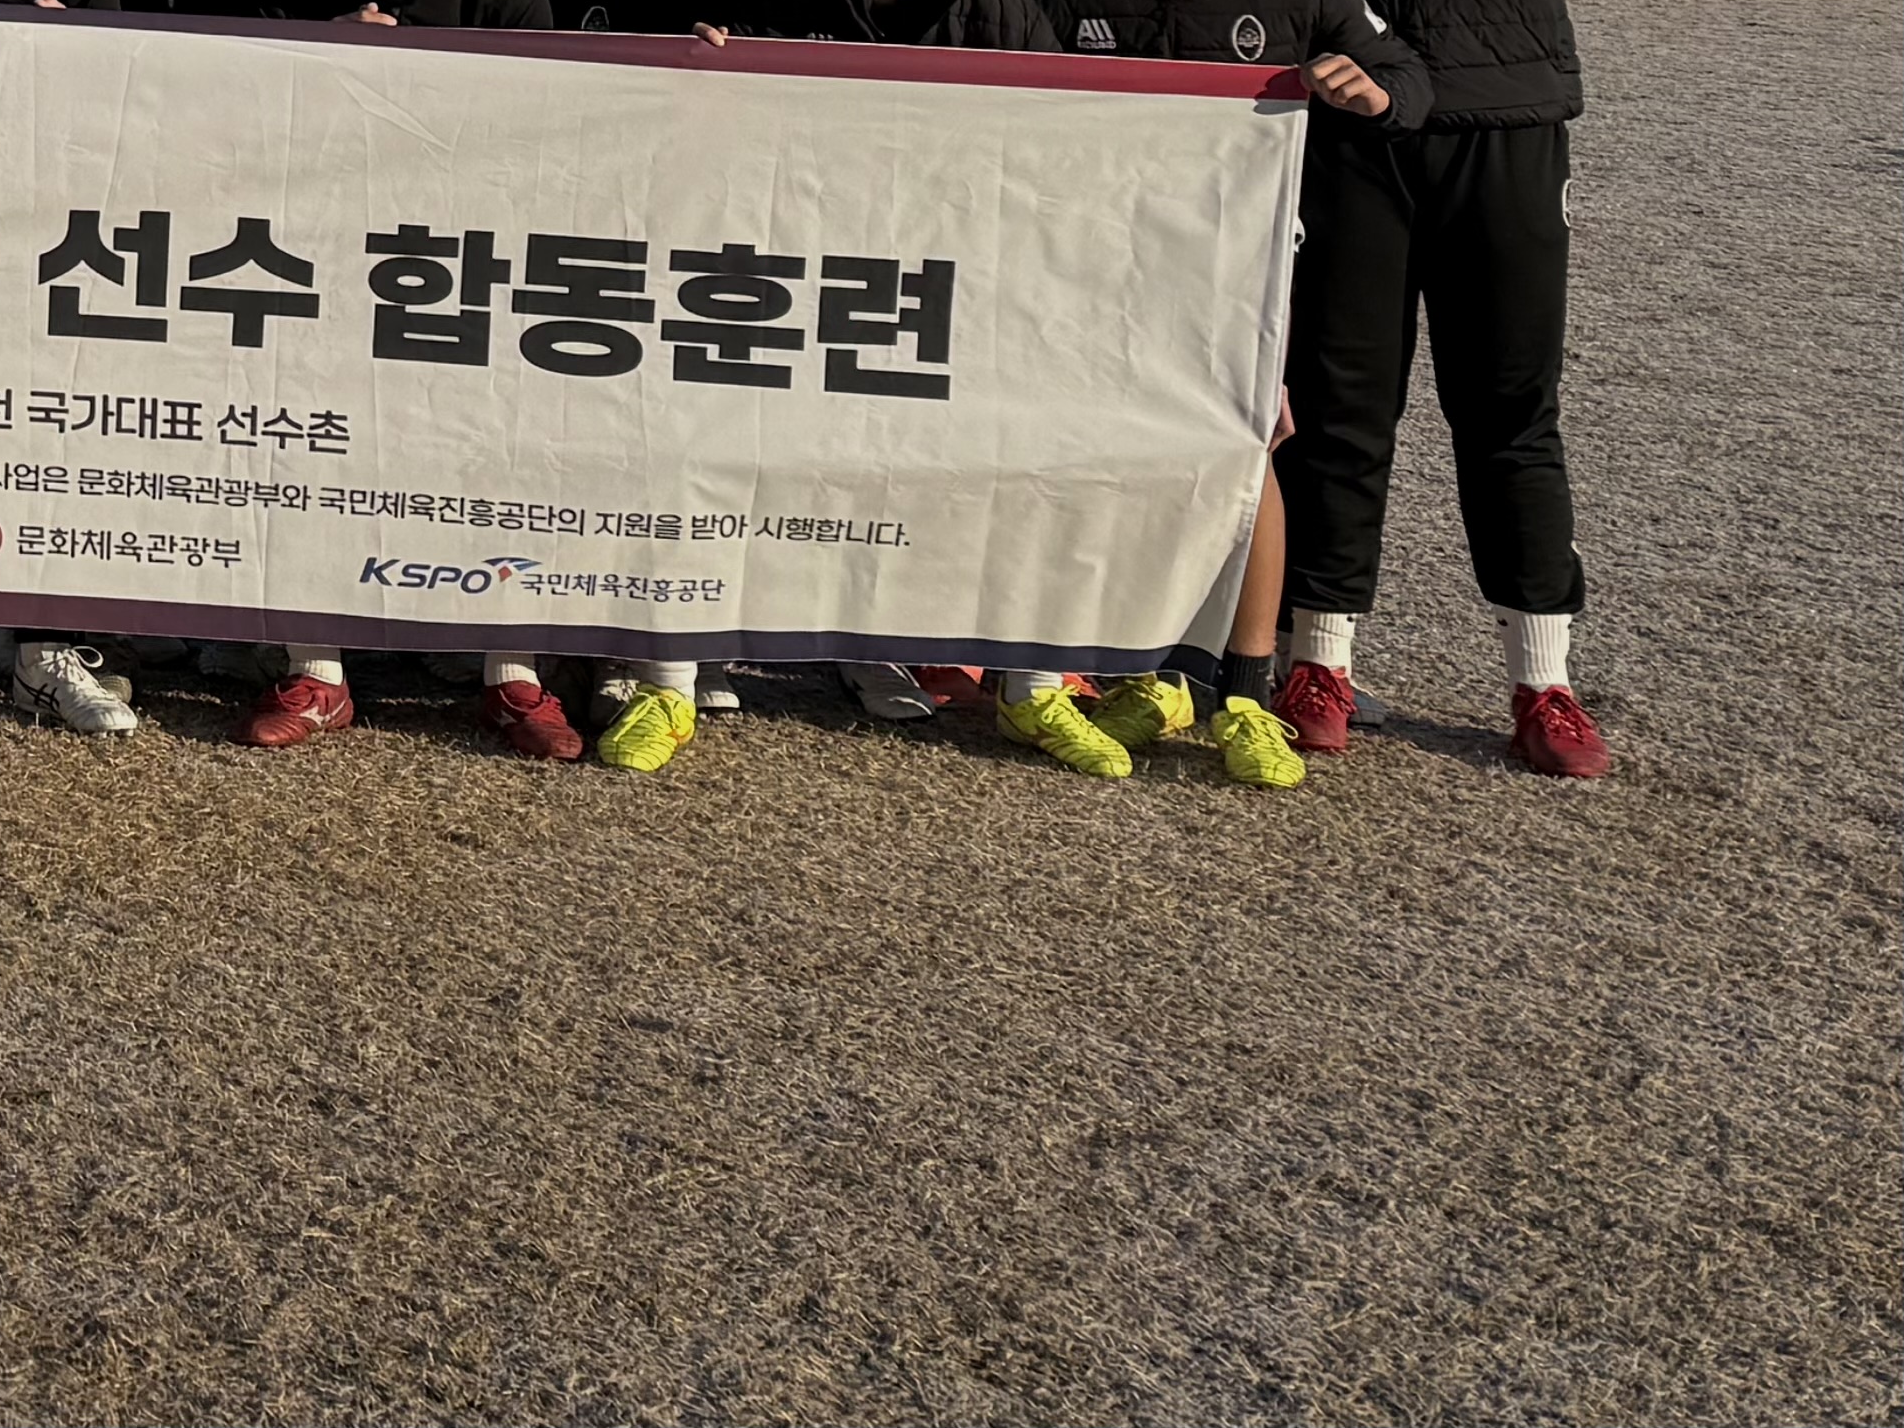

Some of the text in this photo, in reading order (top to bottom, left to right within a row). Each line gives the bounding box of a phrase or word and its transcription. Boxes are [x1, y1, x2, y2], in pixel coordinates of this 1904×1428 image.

[38, 210, 320, 348] 선수
[365, 224, 955, 400] 합동훈련
[27, 391, 203, 441] 국가대표
[217, 405, 350, 454] 선수촌
[78, 469, 311, 511] 문화체육관광부와
[319, 487, 585, 536] 국민체육진흥공단의
[595, 513, 682, 540] 지원을
[692, 515, 748, 539] 받아
[755, 517, 910, 546] 시행합니다.
[17, 526, 241, 568] 문화체육관광부
[360, 557, 491, 593] KSPO
[520, 573, 724, 602] 국민체육진흥공단
